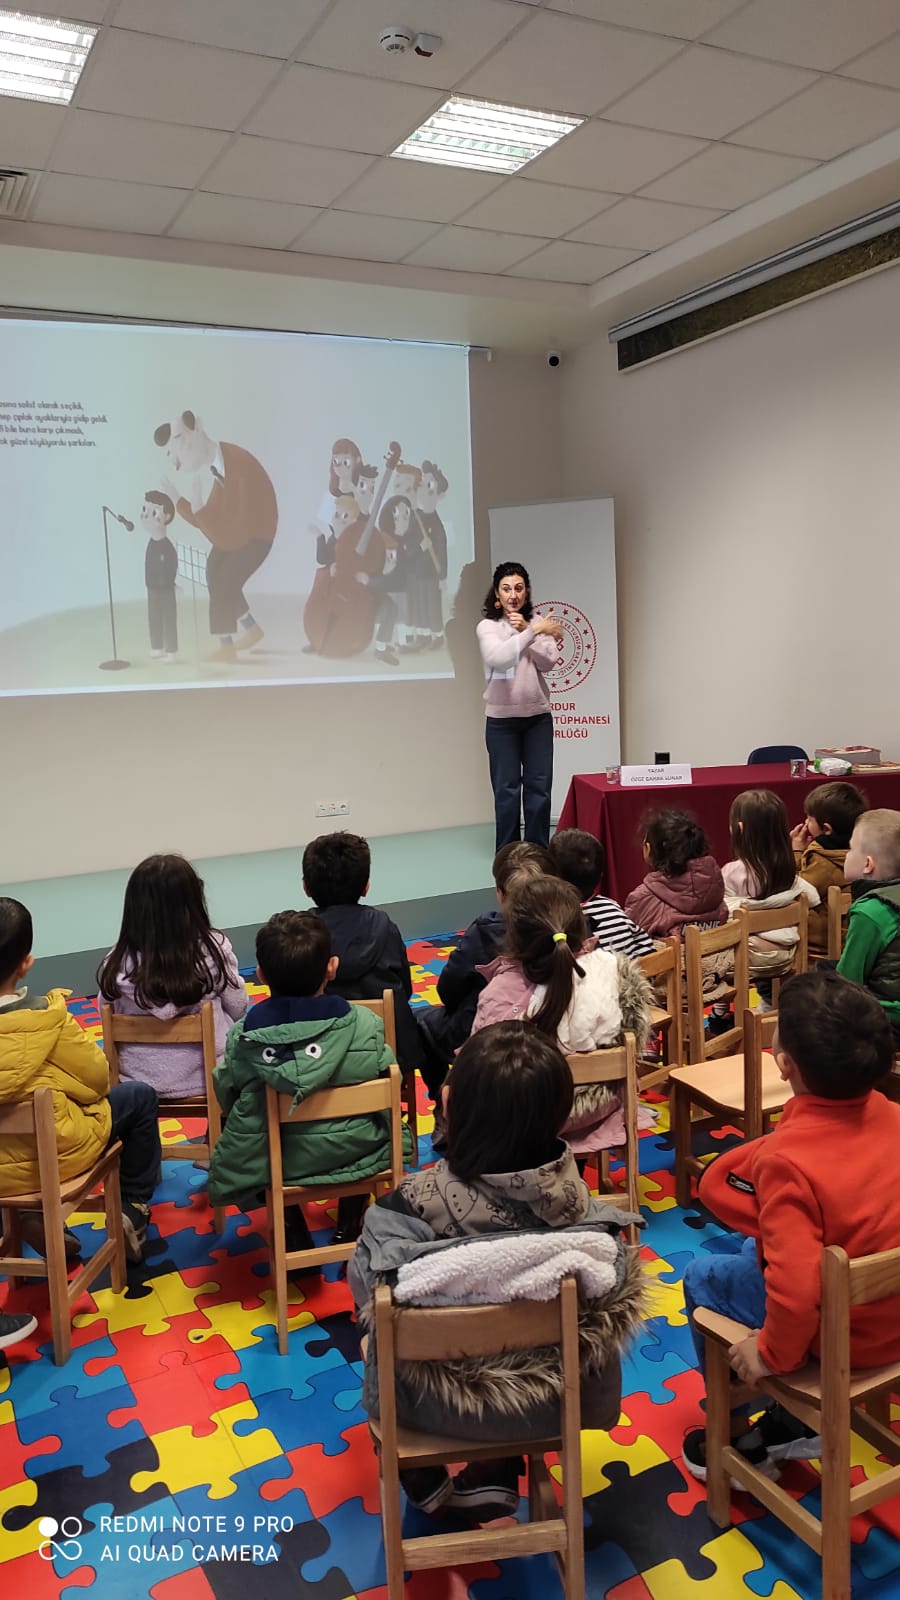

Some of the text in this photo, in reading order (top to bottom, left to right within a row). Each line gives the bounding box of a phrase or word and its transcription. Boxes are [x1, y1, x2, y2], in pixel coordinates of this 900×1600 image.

[37, 400, 58, 409] olarak
[550, 702, 576, 711] RDUR
[554, 714, 610, 725] TÜPHANESİ
[554, 728, 588, 739] RLÜĞÜ
